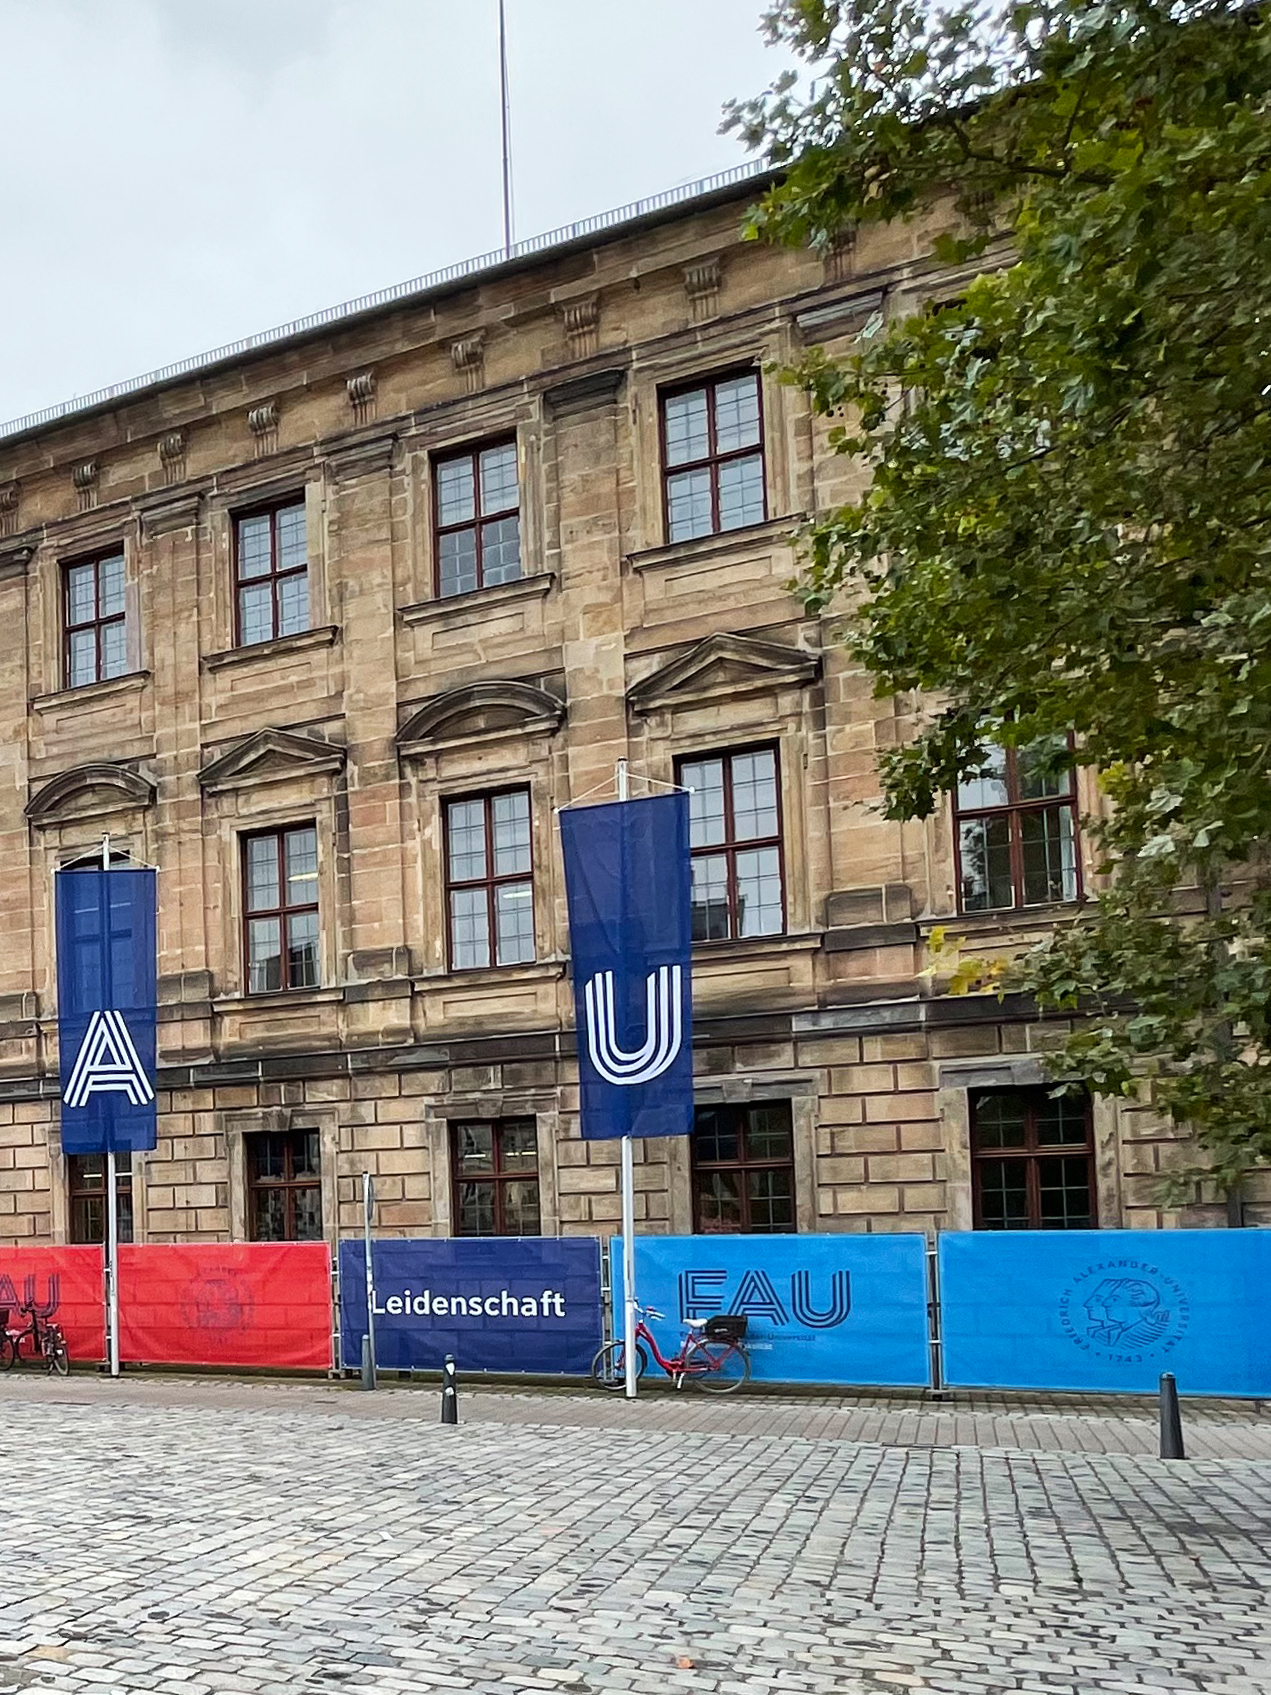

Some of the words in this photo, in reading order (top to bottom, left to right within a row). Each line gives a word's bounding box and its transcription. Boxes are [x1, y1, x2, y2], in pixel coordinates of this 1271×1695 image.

[63, 1010, 155, 1108] A
[584, 965, 682, 1085] U
[371, 1288, 566, 1317] Leidenschaft
[678, 1270, 851, 1329] FAU
